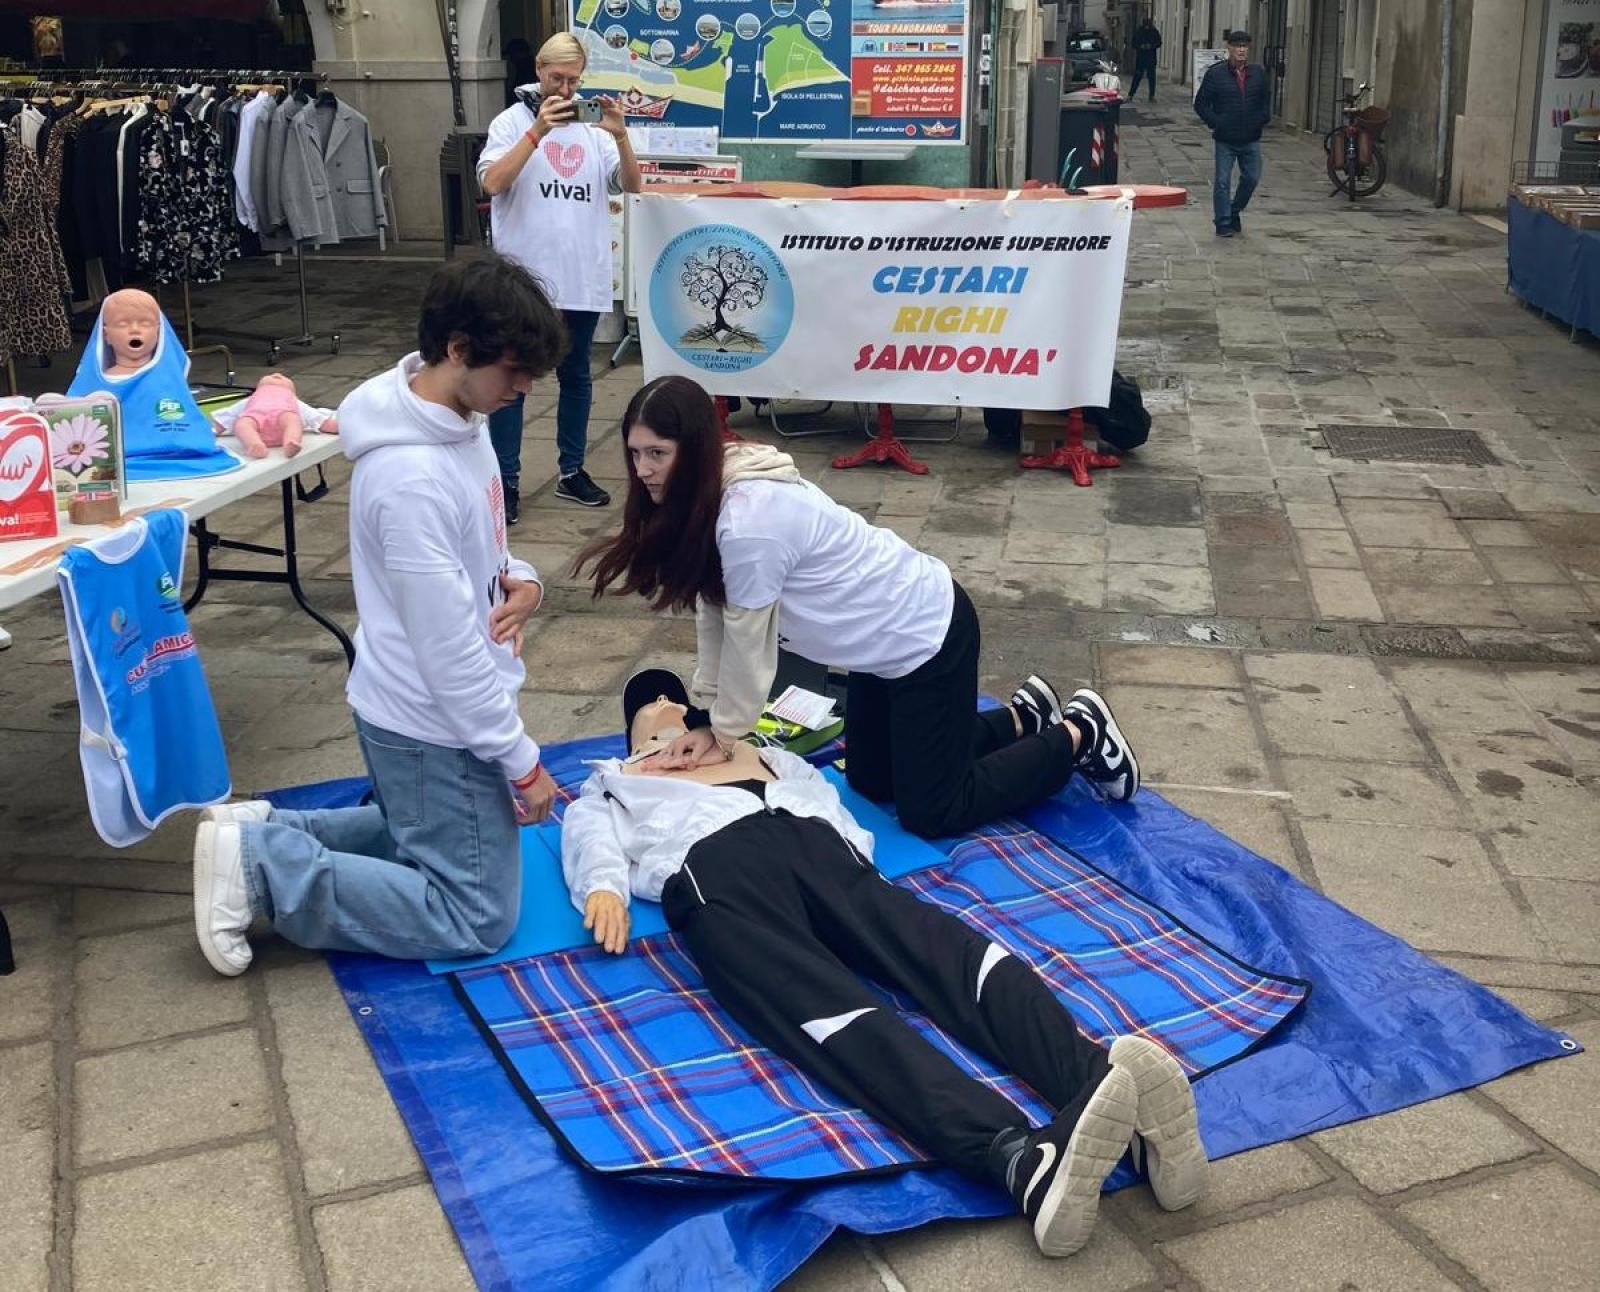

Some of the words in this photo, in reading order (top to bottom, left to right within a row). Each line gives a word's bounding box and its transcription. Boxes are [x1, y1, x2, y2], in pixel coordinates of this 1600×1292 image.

[868, 23, 890, 34] TOUR
[891, 23, 947, 34] PANORAMICO
[539, 179, 591, 203] viva!
[780, 234, 866, 251] ISTITUTO
[867, 234, 1005, 252] D'ISTRUZIONE
[1006, 235, 1112, 252] SUPERIORE
[871, 264, 1030, 296] CESTARI
[893, 305, 1009, 336] RIGHI
[853, 343, 1058, 377] SANDONA'
[160, 400, 181, 413] PEP
